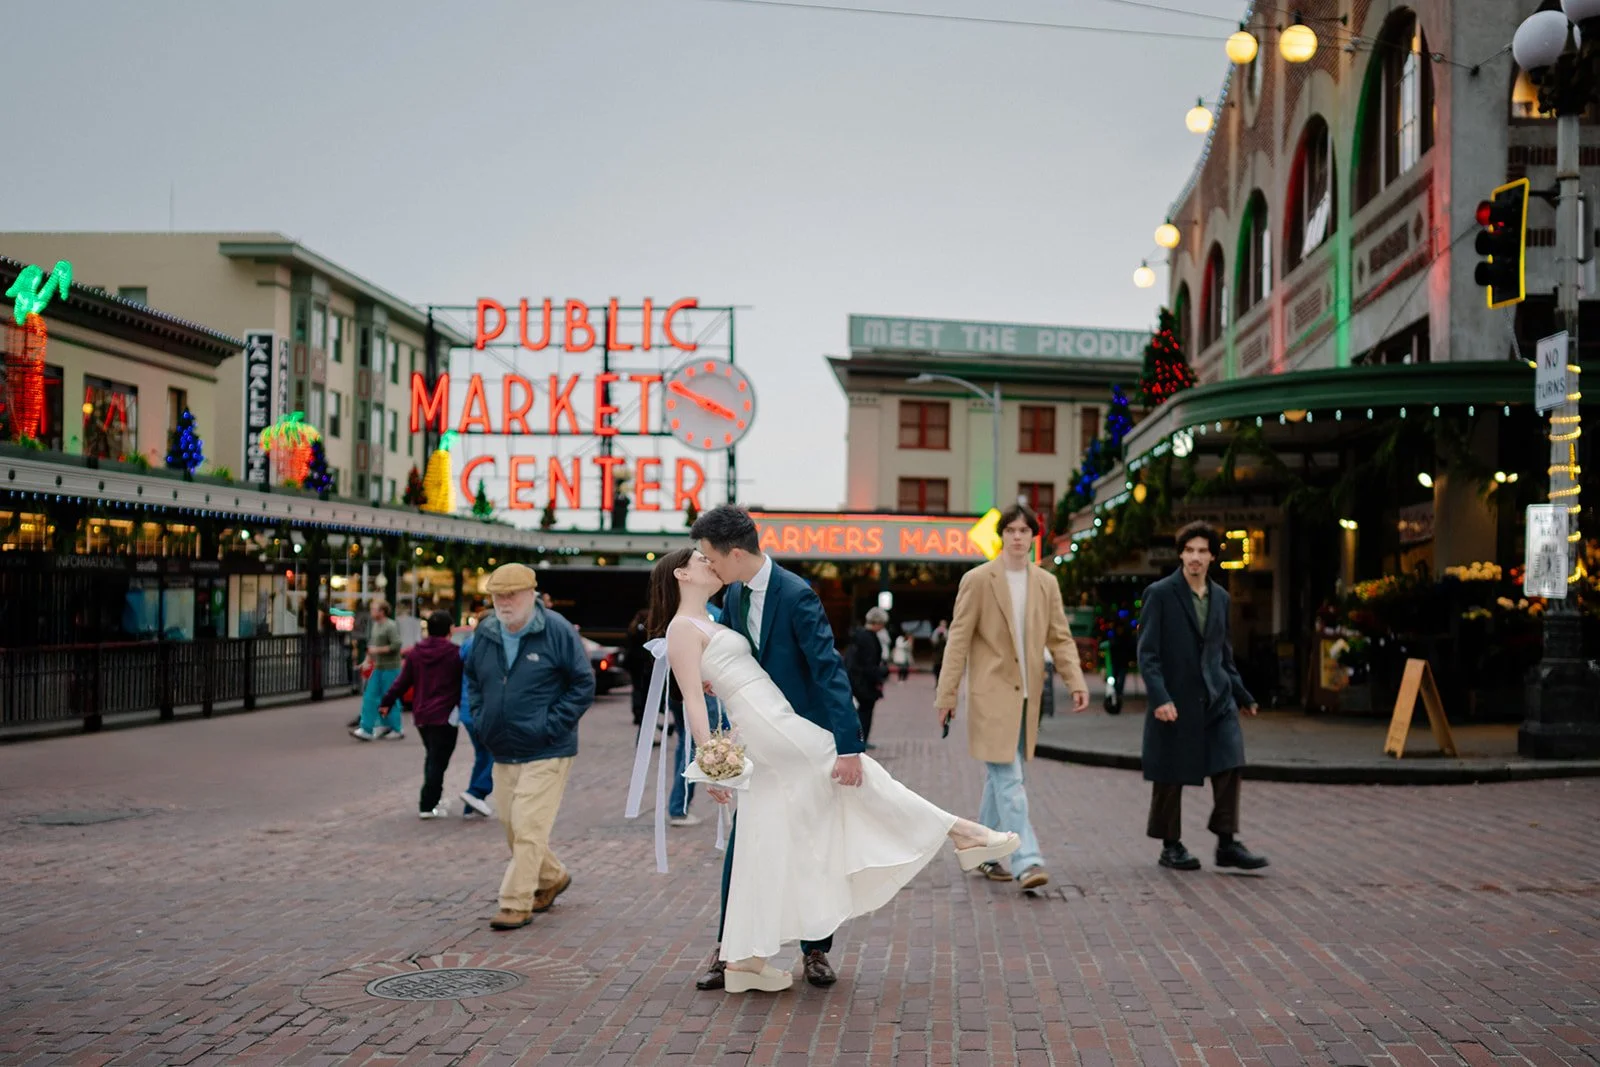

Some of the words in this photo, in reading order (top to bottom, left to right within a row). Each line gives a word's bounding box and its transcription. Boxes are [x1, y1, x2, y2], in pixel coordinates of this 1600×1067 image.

[476, 297, 698, 352] PUBLIC
[863, 320, 944, 347] MEET
[961, 325, 1016, 351] THE
[1545, 348, 1559, 370] NO
[410, 371, 664, 436] MARKET
[1537, 377, 1566, 399] TURNS
[460, 455, 705, 512] CENTER
[755, 523, 883, 554] ARMERS
[56, 555, 114, 568] INFORMATION
